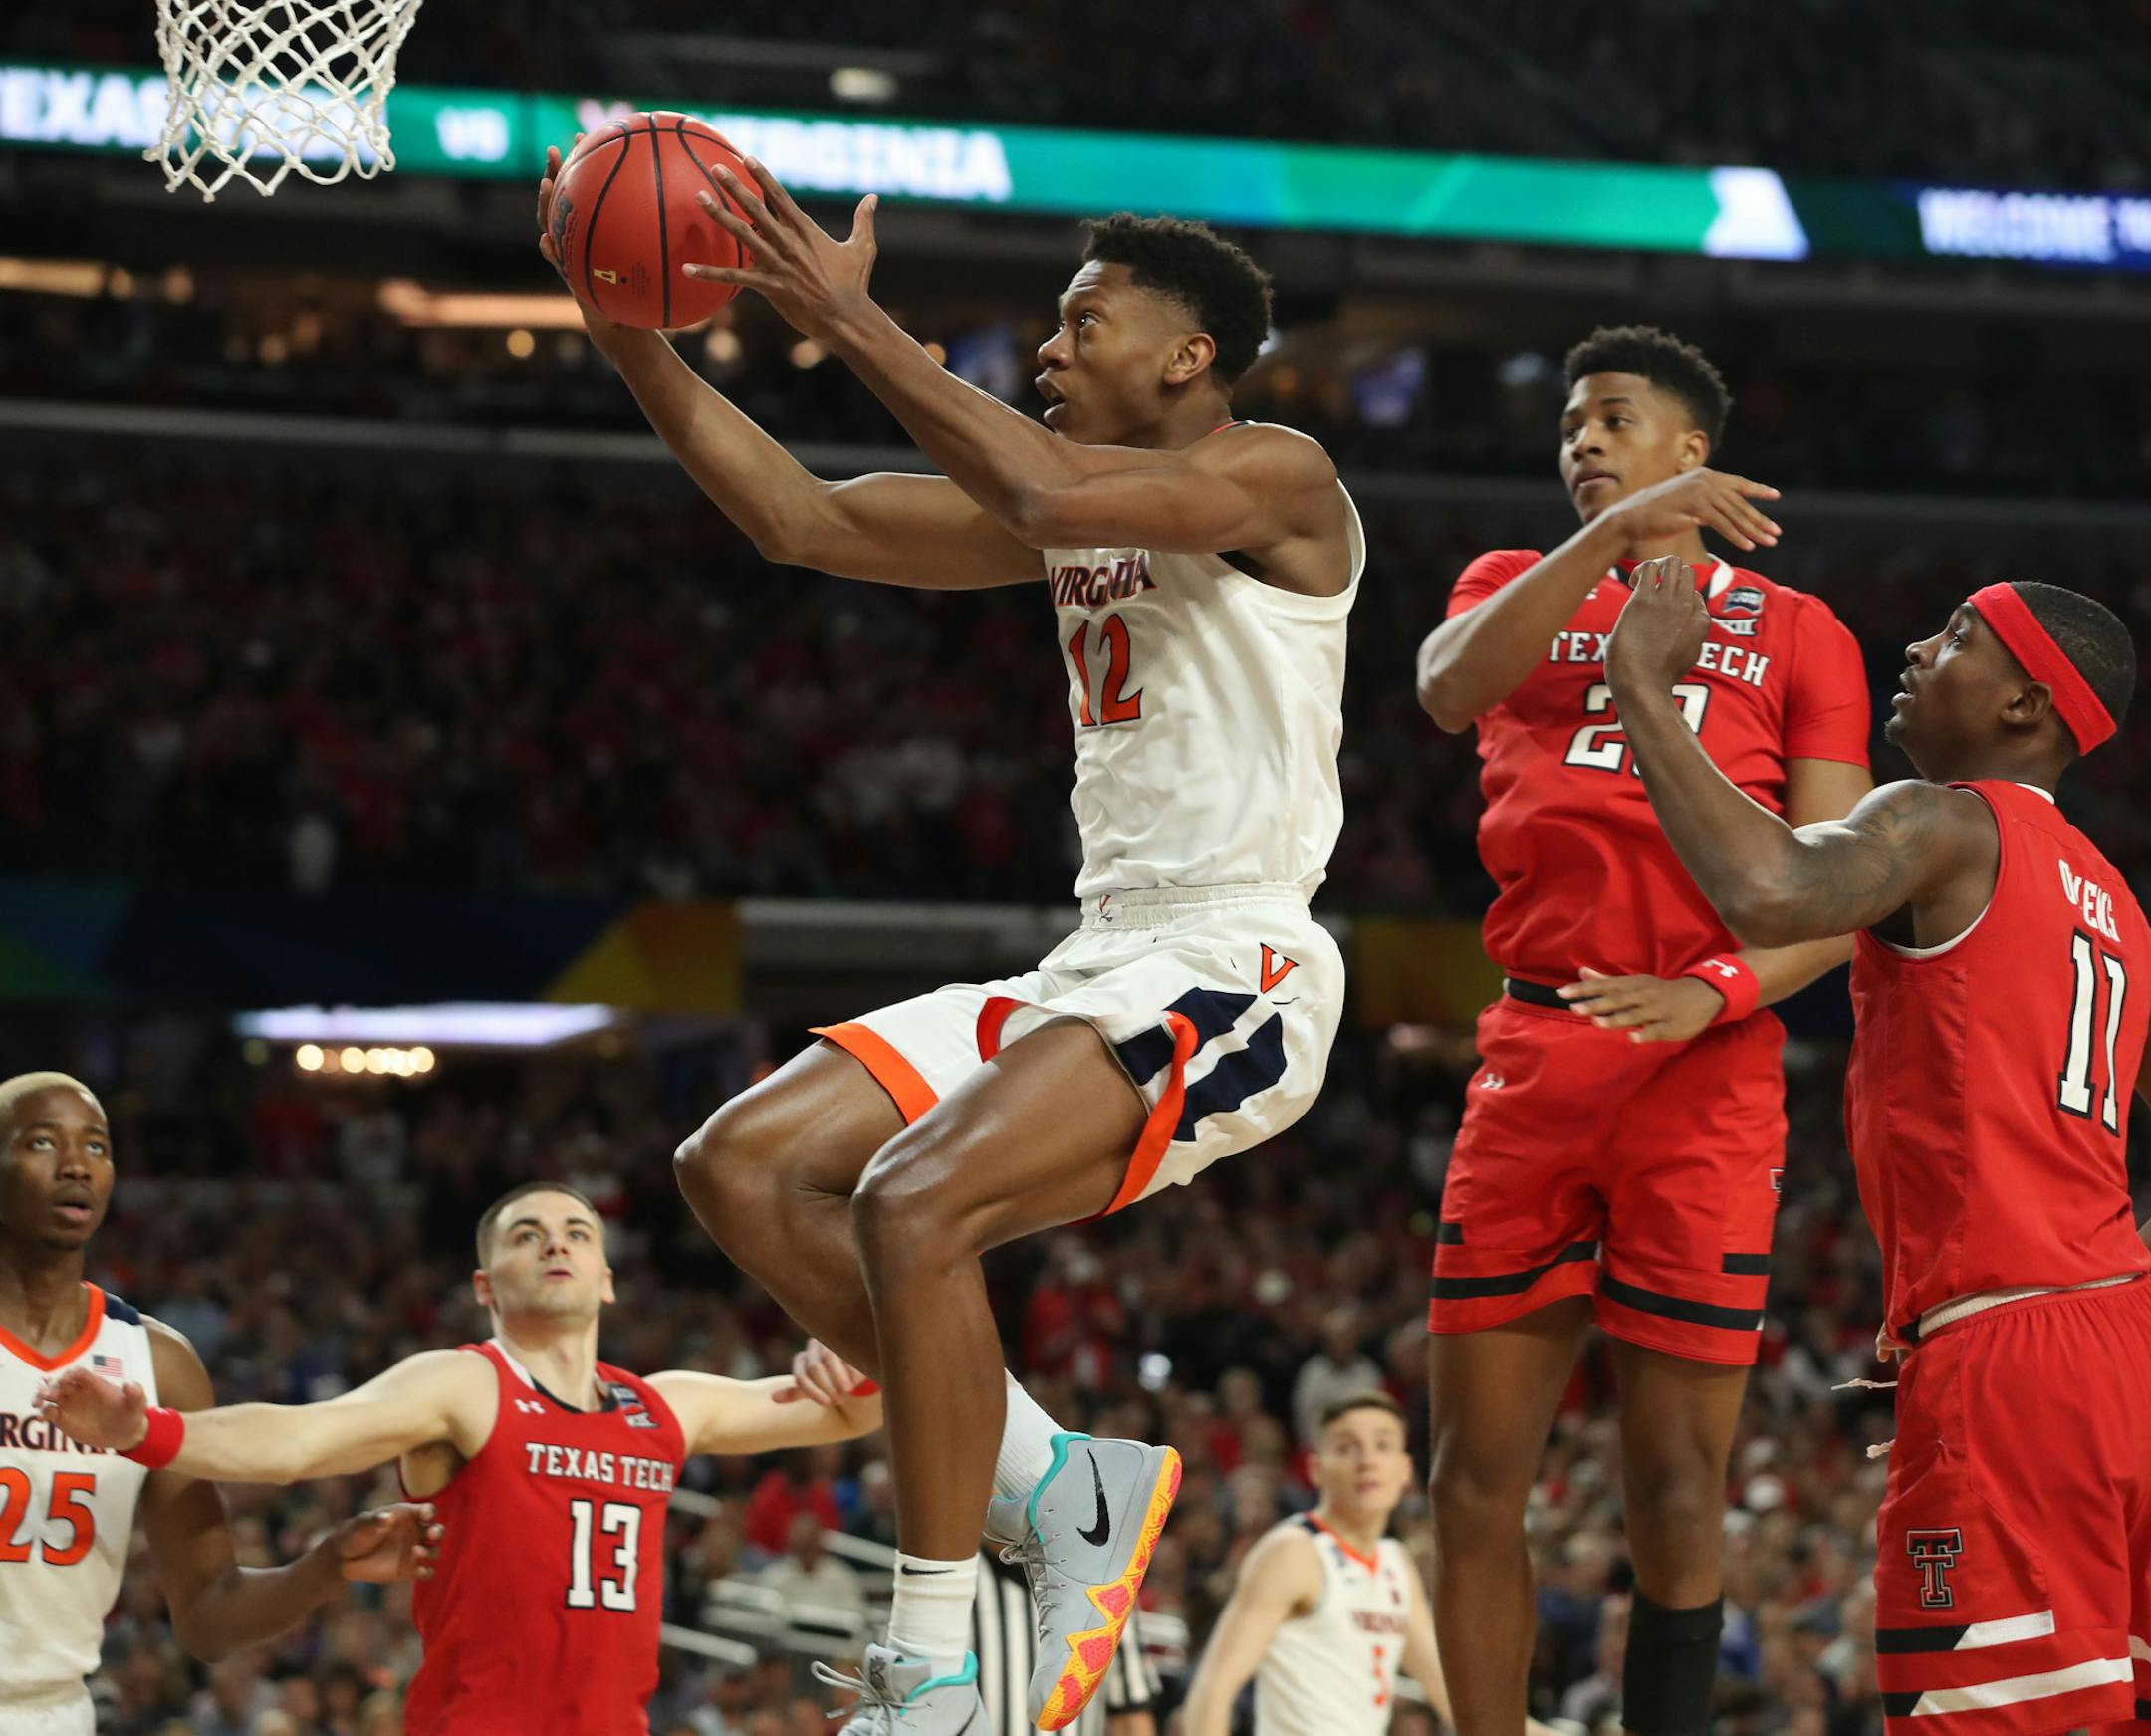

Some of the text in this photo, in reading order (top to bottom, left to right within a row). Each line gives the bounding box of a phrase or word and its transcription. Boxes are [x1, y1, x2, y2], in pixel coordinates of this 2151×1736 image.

[1068, 613, 1144, 727] 12
[2057, 926, 2128, 1138] 11
[0, 1466, 97, 1567] 25
[525, 1441, 674, 1493] TEXAS TECH
[565, 1498, 642, 1612] 13
